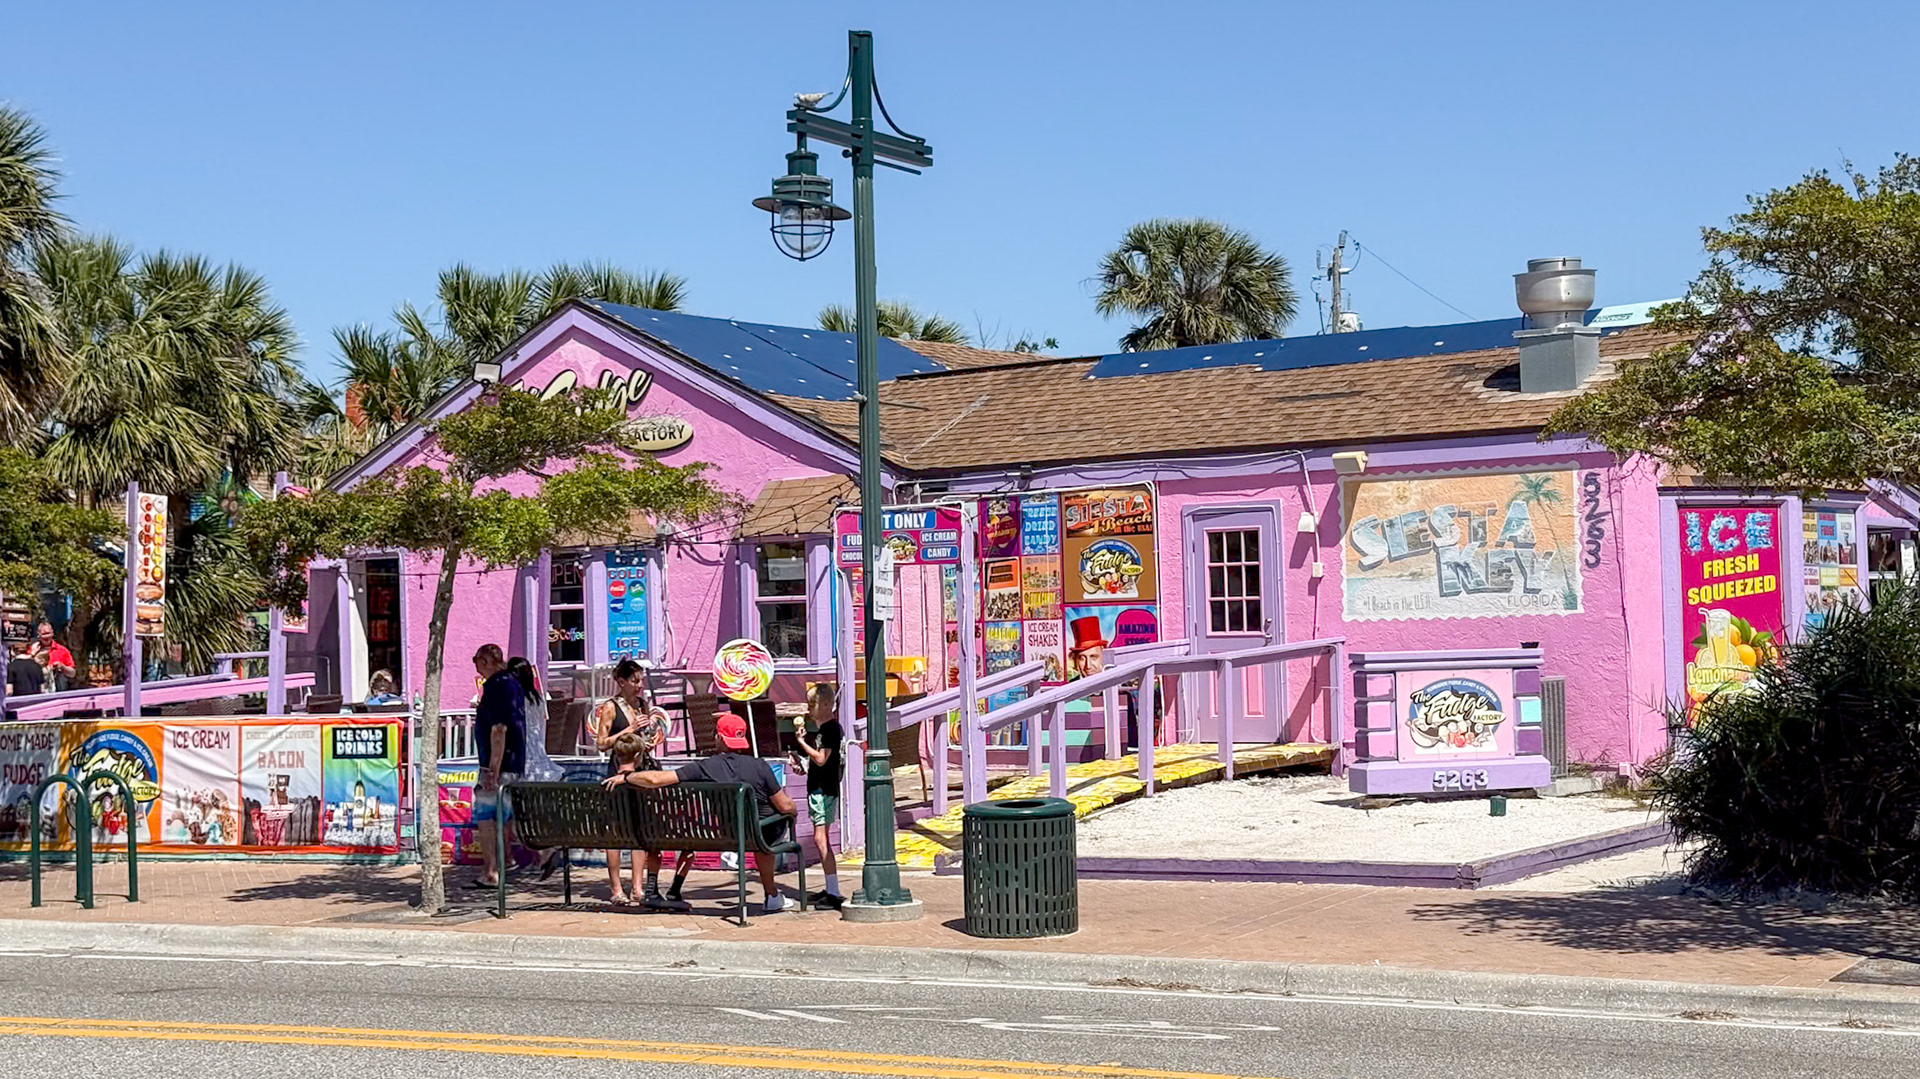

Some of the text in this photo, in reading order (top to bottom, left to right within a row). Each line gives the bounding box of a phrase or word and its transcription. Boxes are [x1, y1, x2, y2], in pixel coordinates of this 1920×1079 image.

[634, 424, 685, 441] ACTORY
[1066, 495, 1148, 528] SIESTA
[1583, 471, 1611, 568] 5263
[894, 512, 927, 529] ONLY
[1025, 521, 1055, 532] DRIED
[1101, 513, 1152, 532] Beach
[143, 502, 152, 578] GOURMET
[846, 532, 957, 546] FUD ICE CREAM
[1025, 534, 1057, 545] CANDY
[1351, 500, 1537, 572] SIESTA
[1684, 510, 1774, 553] ICE
[928, 547, 952, 558] CANDY
[608, 567, 645, 579] COLD
[1437, 542, 1557, 597] KEY
[1703, 553, 1760, 579] FRESH
[1687, 575, 1776, 606] SQUEEZED
[1507, 594, 1559, 607] FLORIDA
[560, 627, 585, 642] Coffee
[1028, 622, 1059, 632] ICE CREAM
[616, 637, 640, 648] ICE
[1028, 634, 1058, 647] SHAKES
[609, 649, 647, 660] COLD
[1410, 690, 1432, 704] The
[1425, 690, 1489, 725] Fudge
[0, 733, 55, 750] OME MADE
[172, 730, 231, 749] ICE CREAM
[336, 729, 383, 741] ICE COLD
[336, 741, 383, 755] DRINKS
[257, 751, 305, 769] BACON
[1432, 769, 1489, 790] 5263
